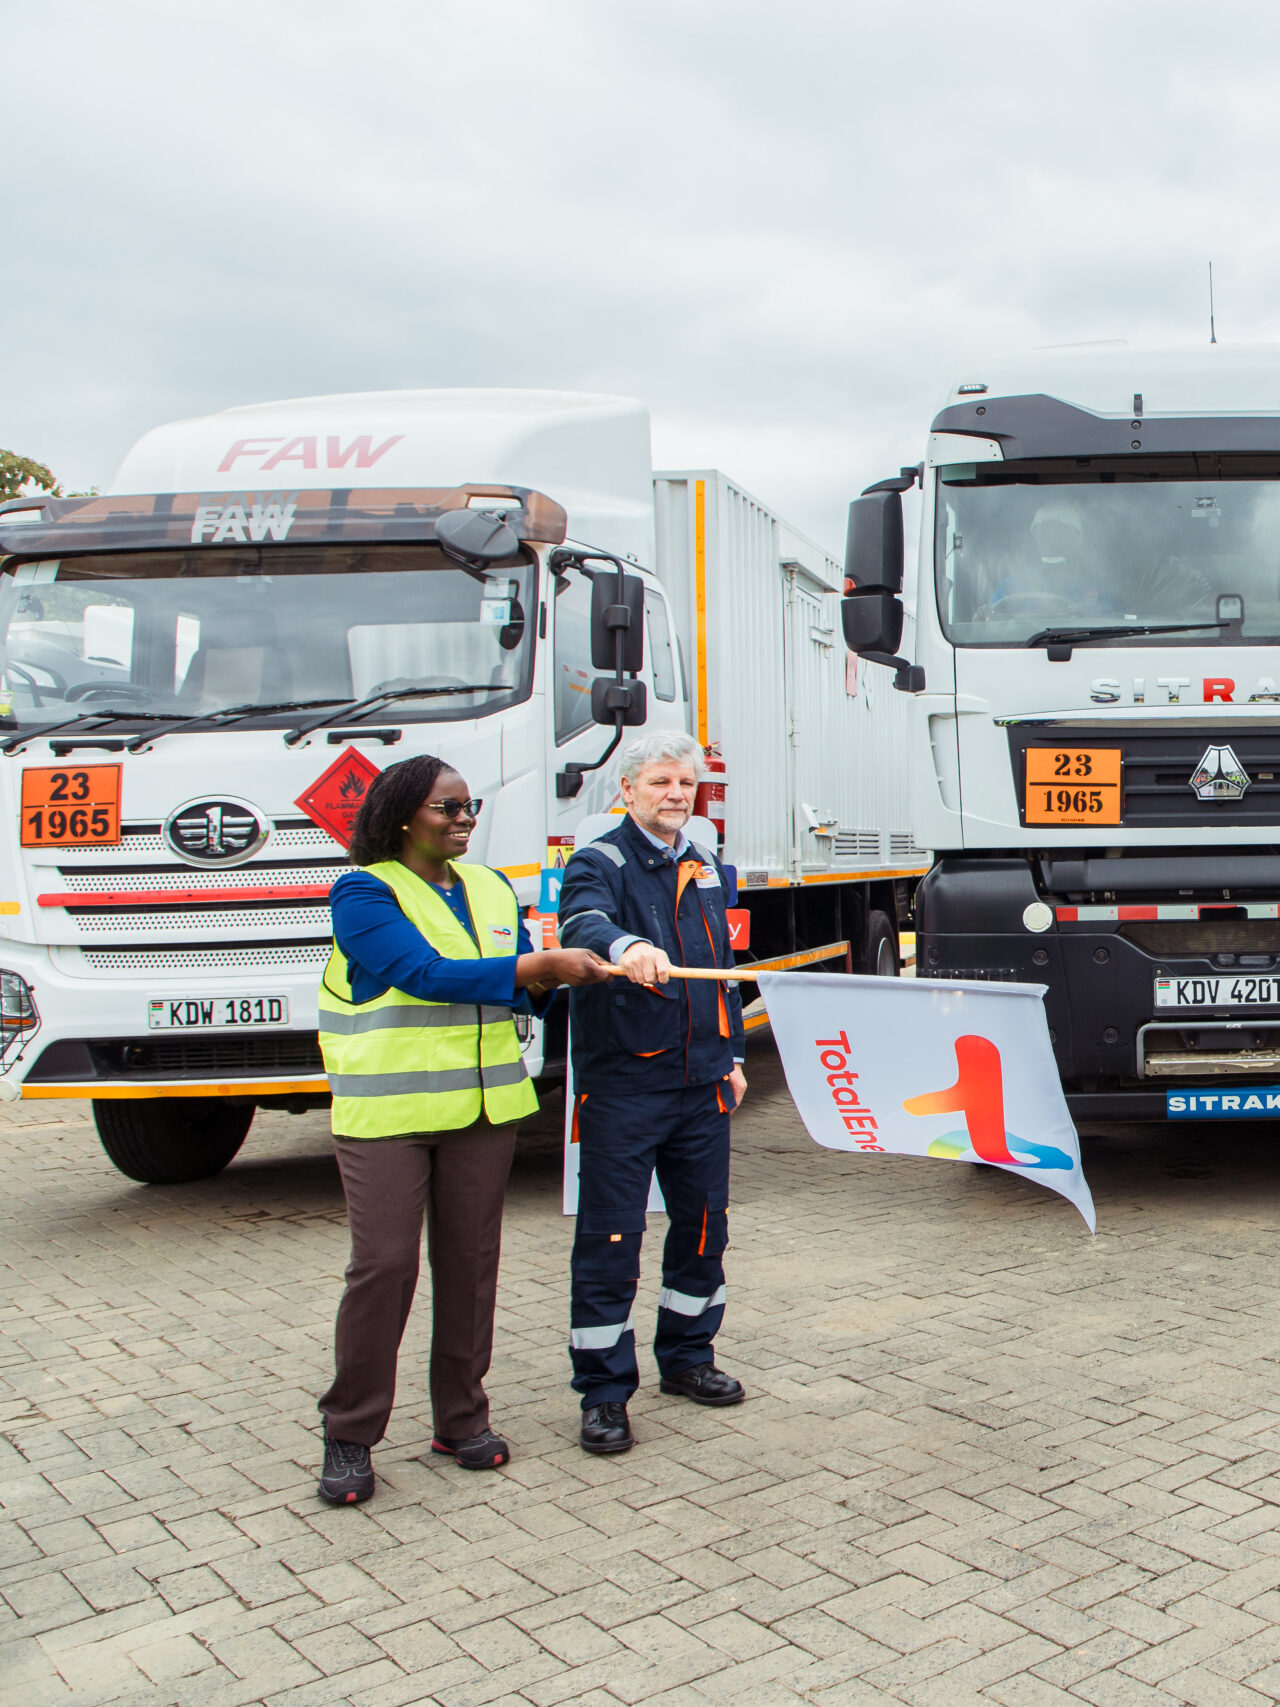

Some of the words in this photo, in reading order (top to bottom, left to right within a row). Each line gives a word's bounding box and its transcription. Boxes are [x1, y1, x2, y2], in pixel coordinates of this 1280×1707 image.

[216, 434, 406, 473] FAW
[190, 516, 296, 544] FAW
[1055, 753, 1092, 776] 23
[50, 772, 90, 801] 23
[1043, 790, 1103, 813] 1965
[28, 809, 110, 839] 1965
[1177, 980, 1220, 1005] KDV
[170, 1001, 214, 1026] KDW
[225, 999, 282, 1024] 181D
